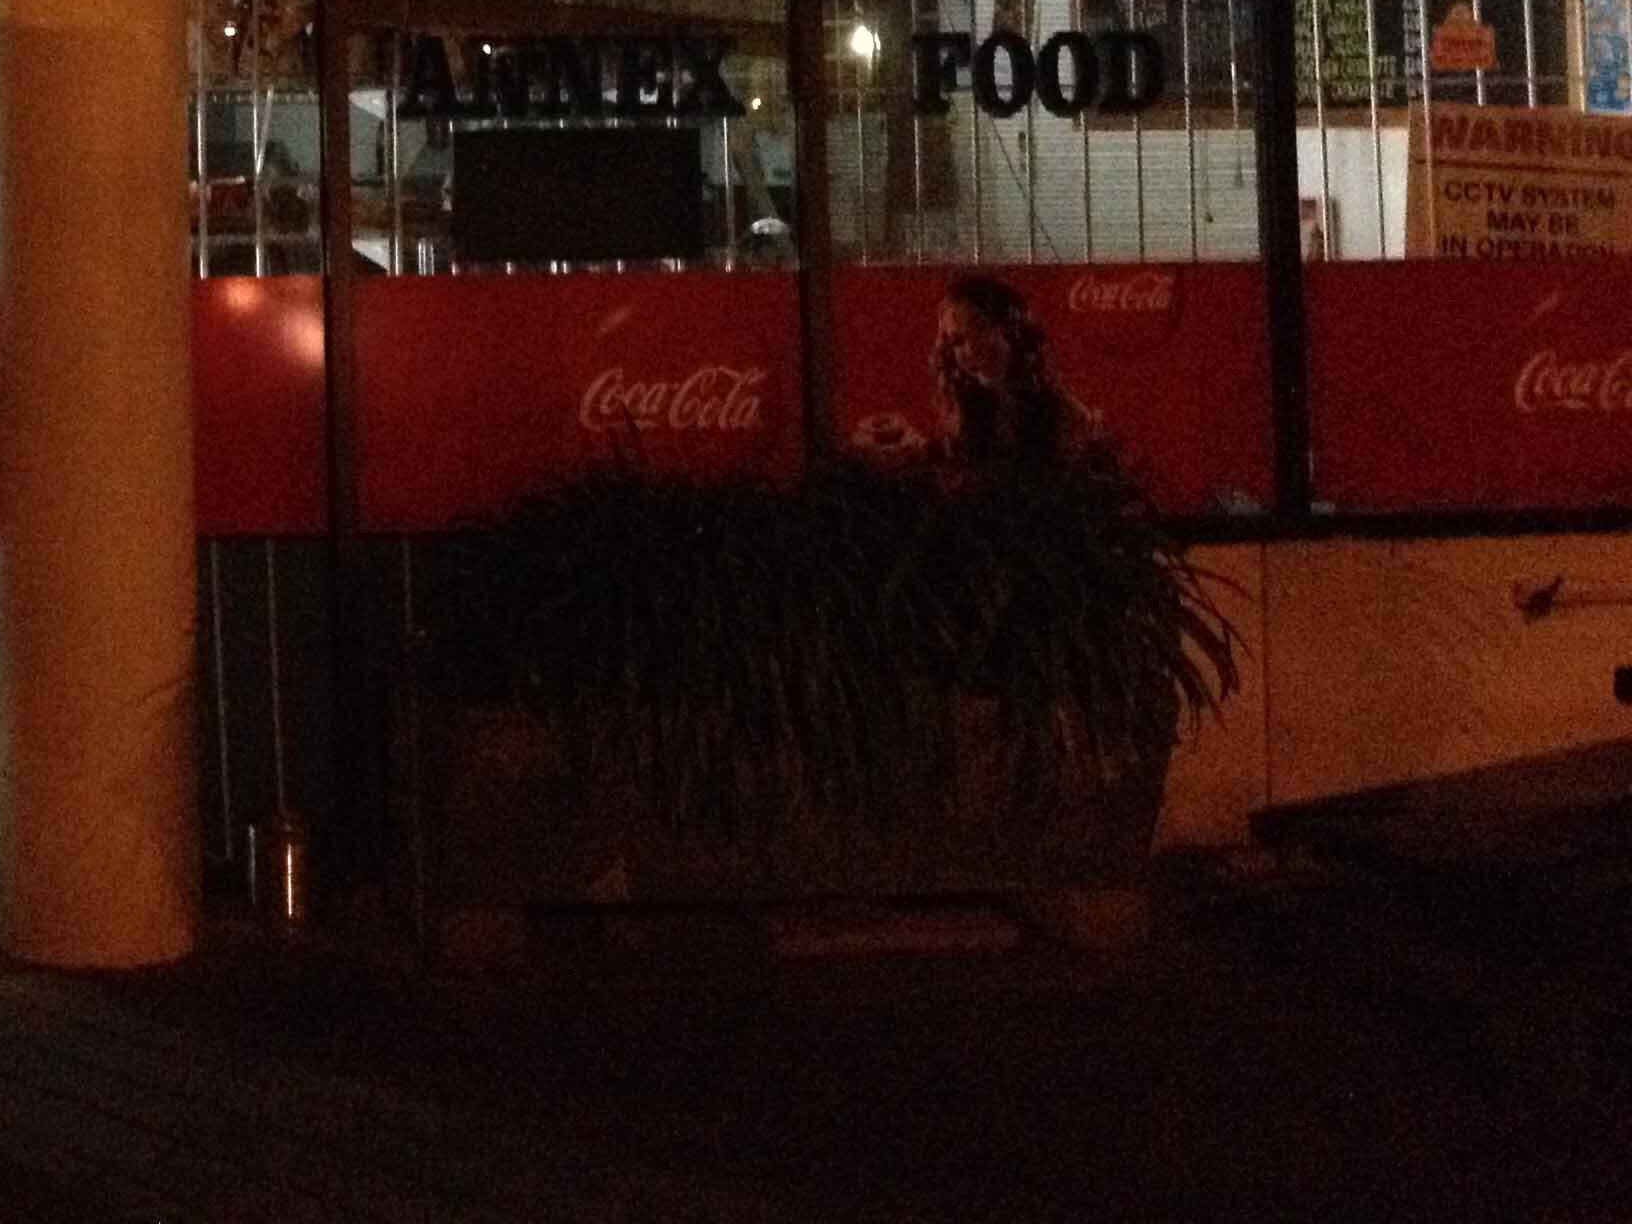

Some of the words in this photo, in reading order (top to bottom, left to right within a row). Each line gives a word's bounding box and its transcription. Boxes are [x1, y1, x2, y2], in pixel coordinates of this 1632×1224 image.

[911, 31, 1163, 118] FOOD
[1443, 181, 1514, 204] CCTV
[1486, 210, 1541, 232] MAY
